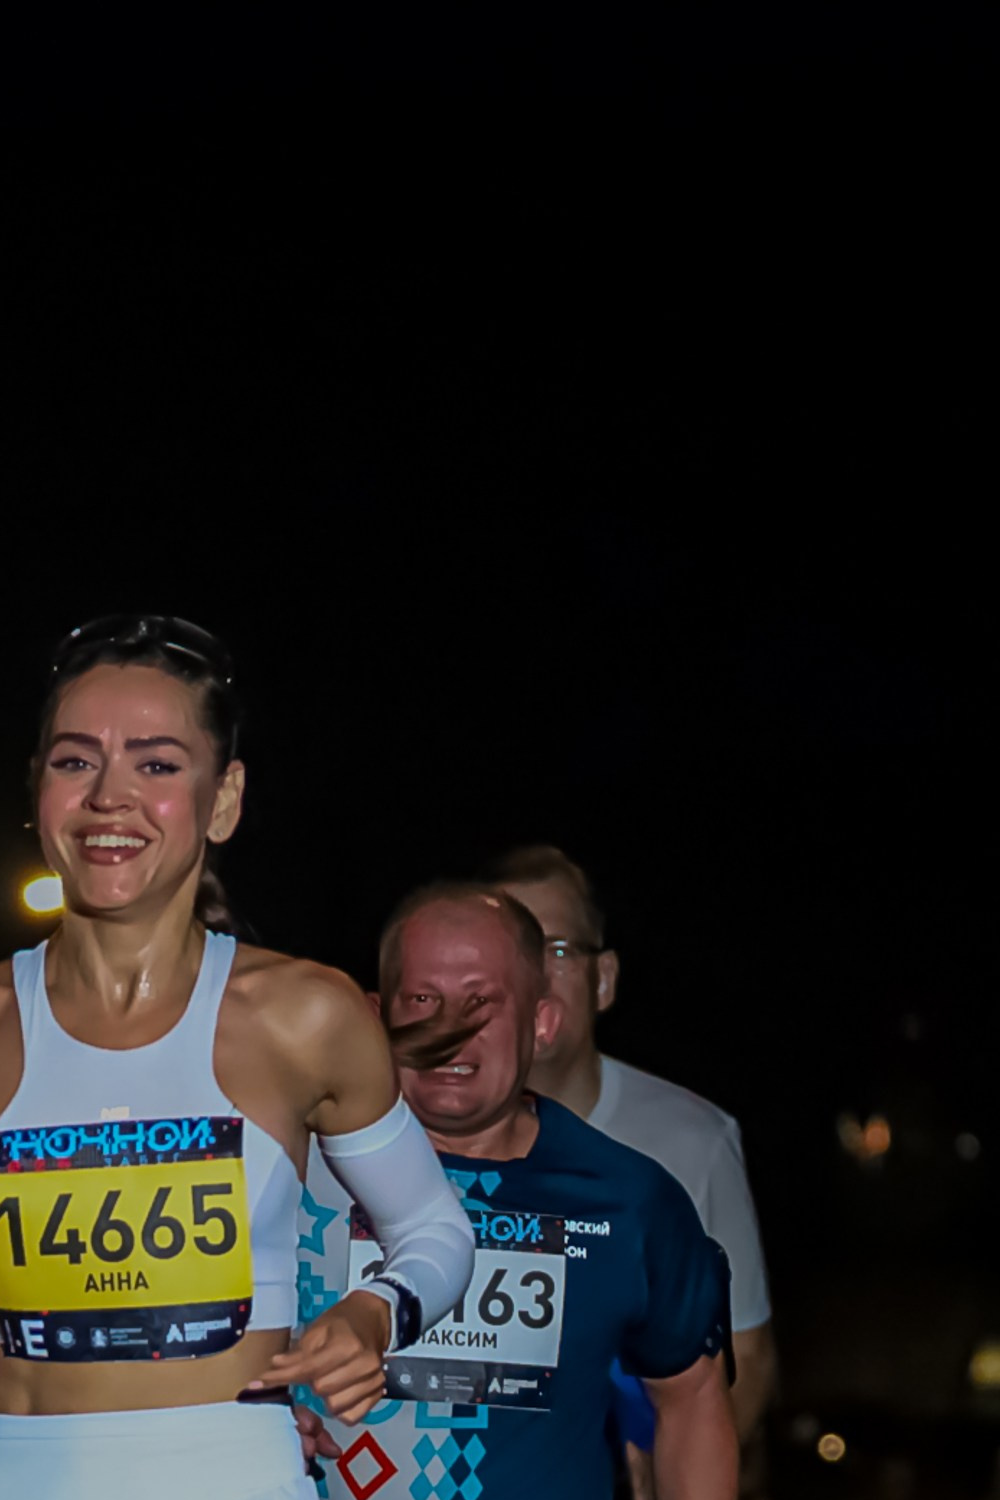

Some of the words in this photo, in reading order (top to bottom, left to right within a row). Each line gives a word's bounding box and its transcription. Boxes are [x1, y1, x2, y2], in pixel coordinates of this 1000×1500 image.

[3, 1118, 215, 1160] НОЧНОЙ
[84, 1271, 149, 1293] АННА
[20, 1319, 50, 1358] E
